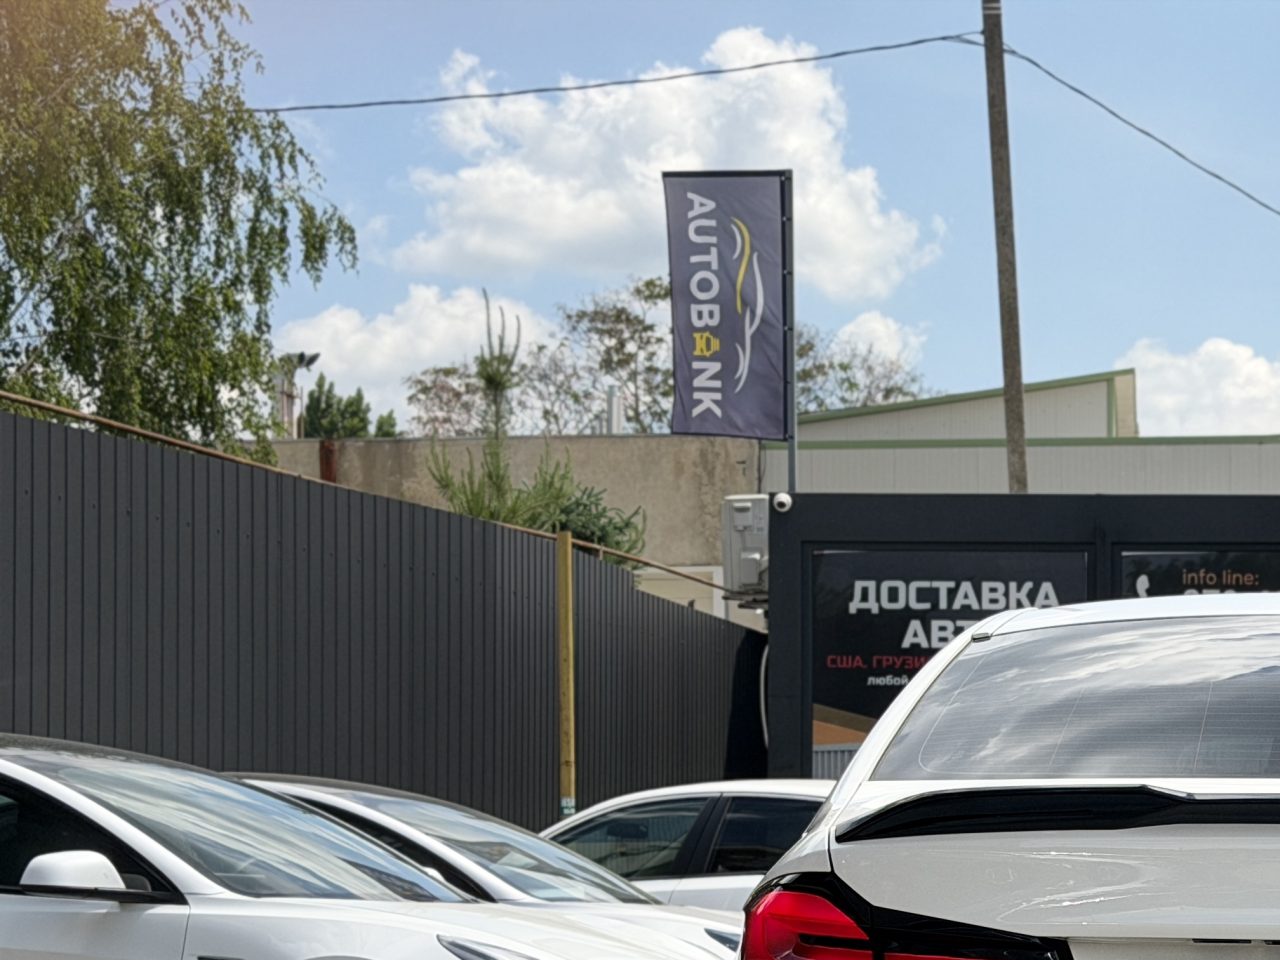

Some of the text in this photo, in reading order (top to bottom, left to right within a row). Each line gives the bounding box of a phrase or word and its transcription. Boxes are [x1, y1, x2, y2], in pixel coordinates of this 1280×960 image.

[1182, 570, 1260, 586] info line:
[848, 580, 1060, 614] ДОСТАВКА
[866, 675, 909, 686] любой
